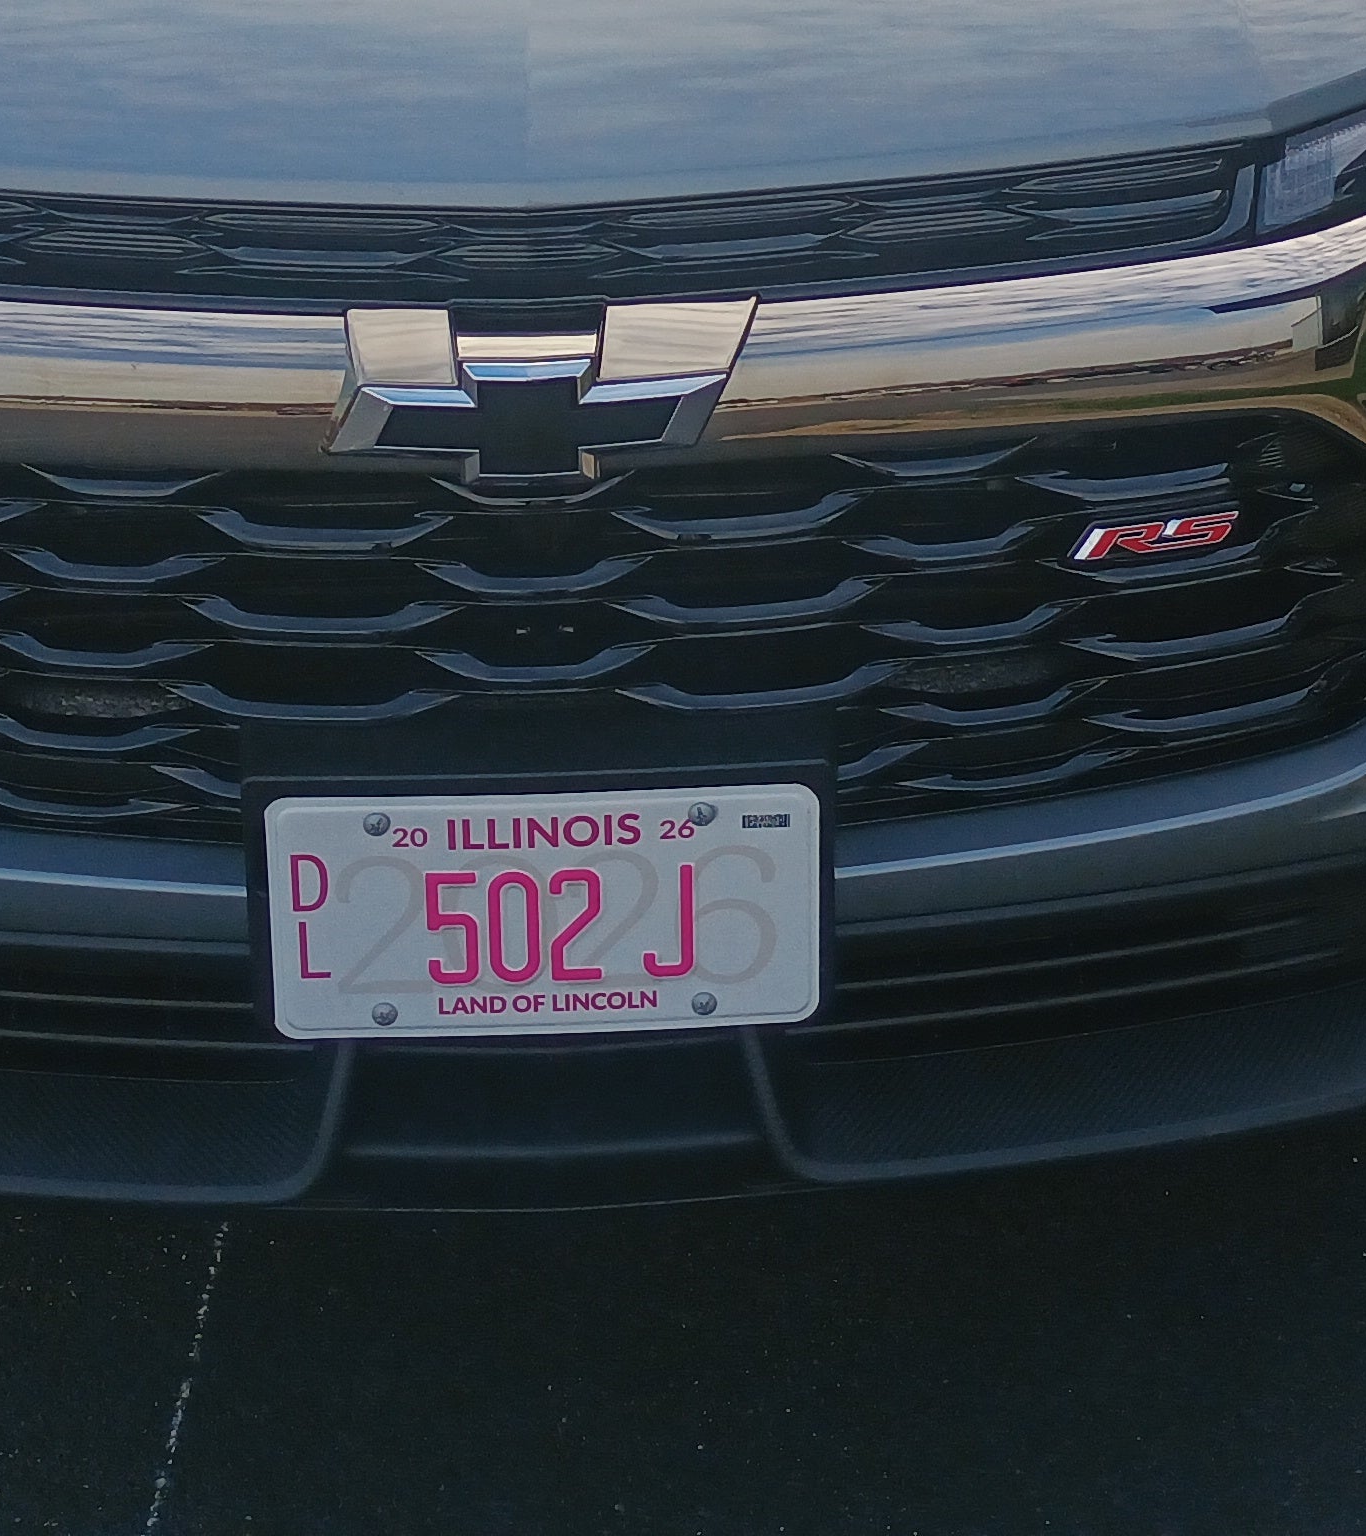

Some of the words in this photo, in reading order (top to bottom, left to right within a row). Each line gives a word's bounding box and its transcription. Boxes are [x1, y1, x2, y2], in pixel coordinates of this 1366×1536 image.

[1073, 510, 1240, 561] RS
[392, 827, 428, 848] 20
[447, 813, 641, 851] ILLINOIS
[659, 819, 695, 840] 26
[425, 868, 603, 985] 502
[642, 864, 695, 978] J
[438, 994, 507, 1015] LAND
[512, 994, 546, 1013] OF
[551, 990, 658, 1013] LINCOLN
